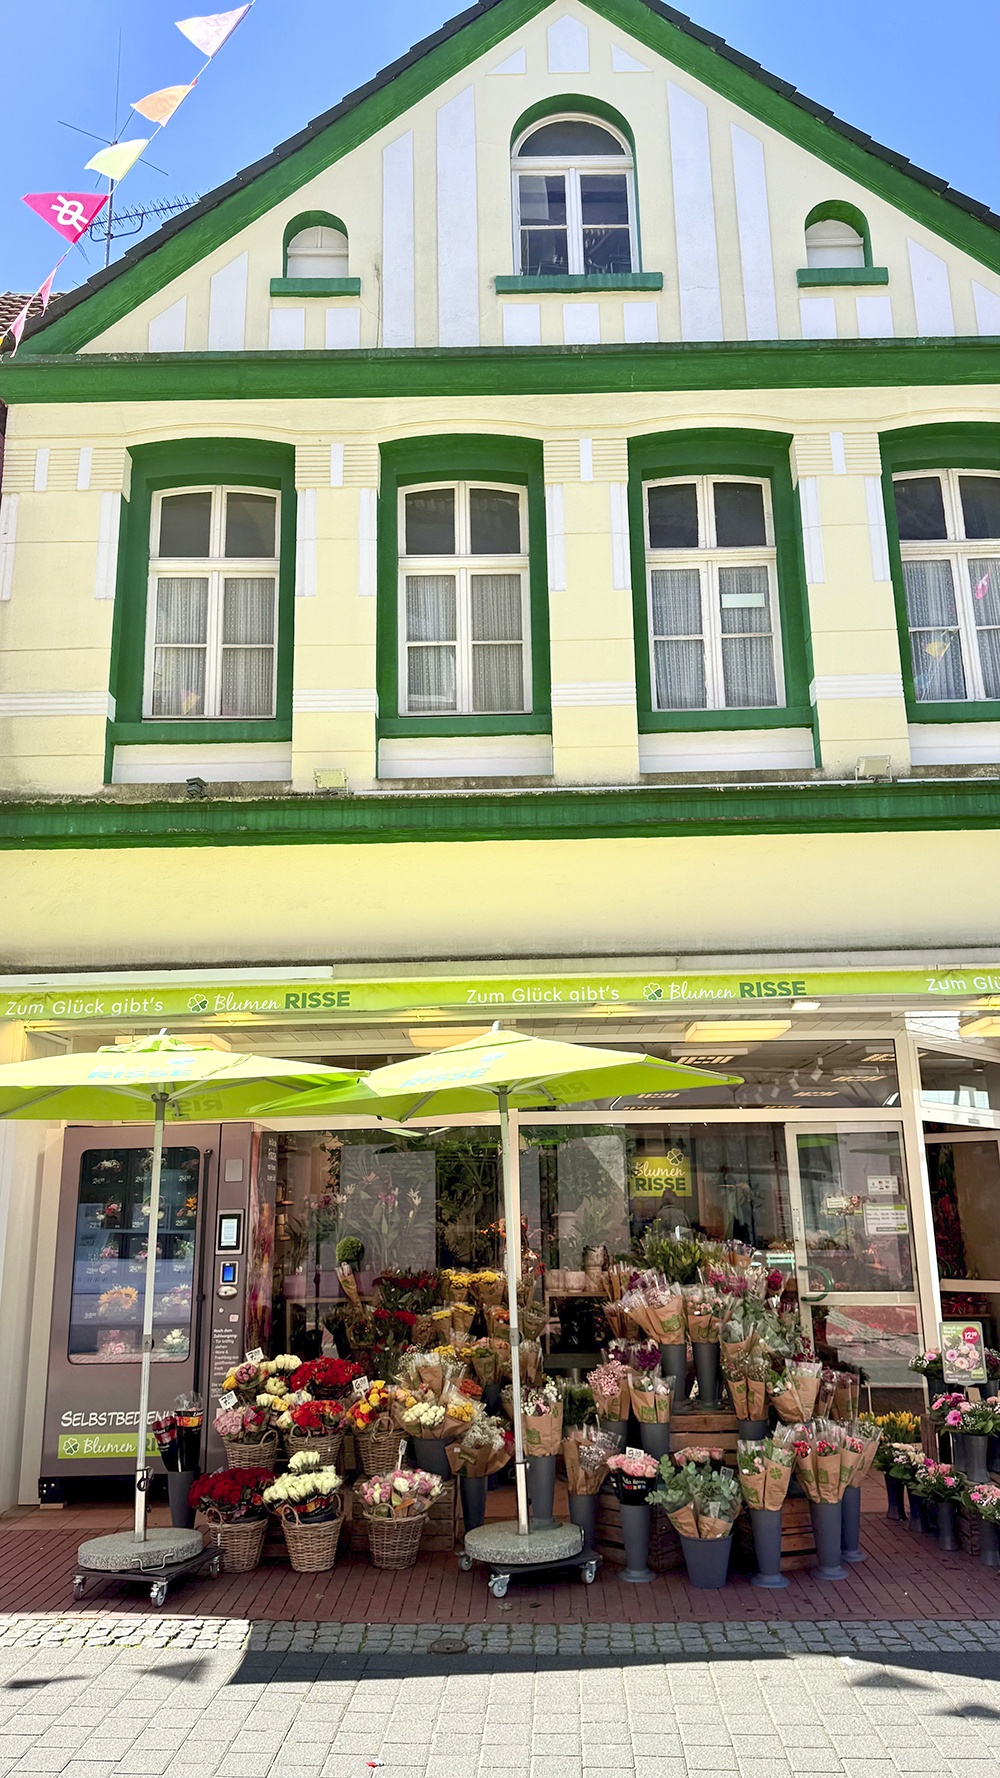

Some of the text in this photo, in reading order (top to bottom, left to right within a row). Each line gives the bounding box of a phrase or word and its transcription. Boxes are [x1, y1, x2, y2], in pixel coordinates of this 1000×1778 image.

[669, 980, 807, 1000] Blumen RISSE
[925, 978, 967, 991] Zum
[214, 991, 350, 1011] Blumen RISSE
[466, 989, 505, 1004] Zum
[512, 986, 563, 1003] Glück
[5, 997, 164, 1016] Zum Glück gibt's
[86, 1069, 193, 1079] RISSE
[399, 1067, 492, 1088] RISSE
[635, 1177, 686, 1191] RISSE
[83, 1436, 137, 1454] Blumen
